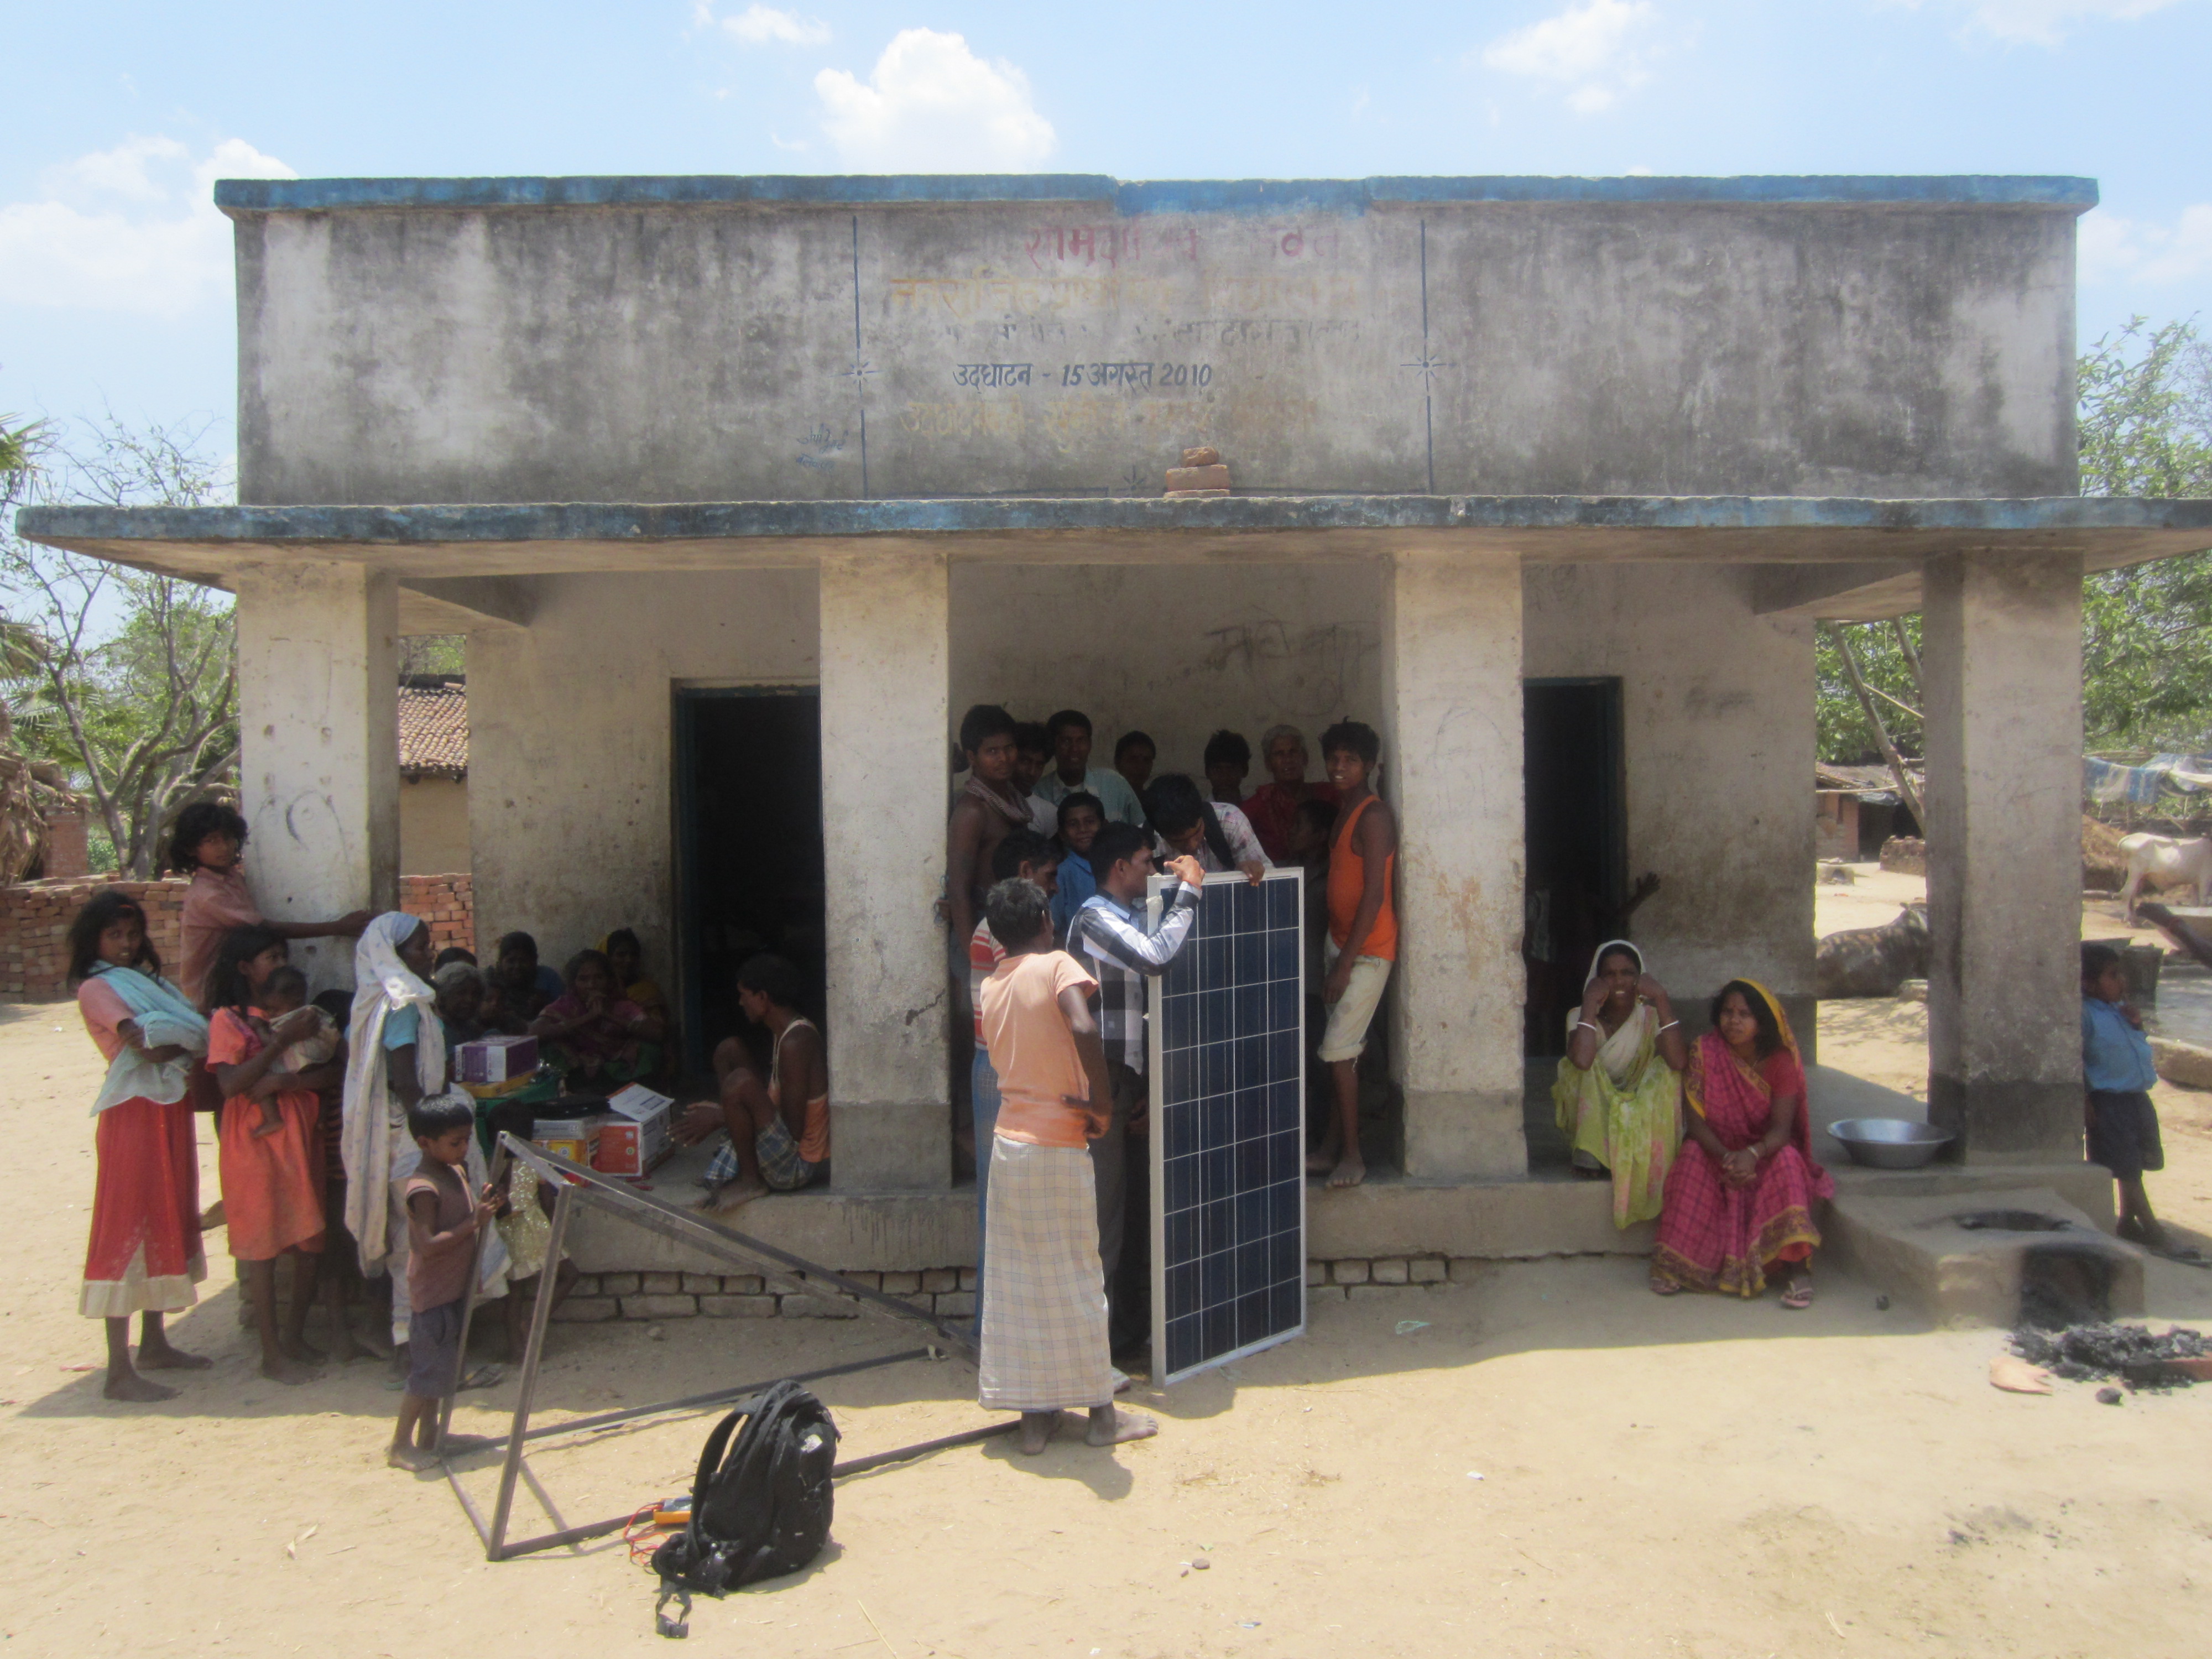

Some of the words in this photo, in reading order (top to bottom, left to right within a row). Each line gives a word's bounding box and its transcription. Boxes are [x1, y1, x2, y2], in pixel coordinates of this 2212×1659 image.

[953, 363, 1034, 394] उद्घाटन
[1061, 364, 1084, 387] 15
[1086, 362, 1155, 394] अगस्त
[1159, 362, 1213, 387] 2010
